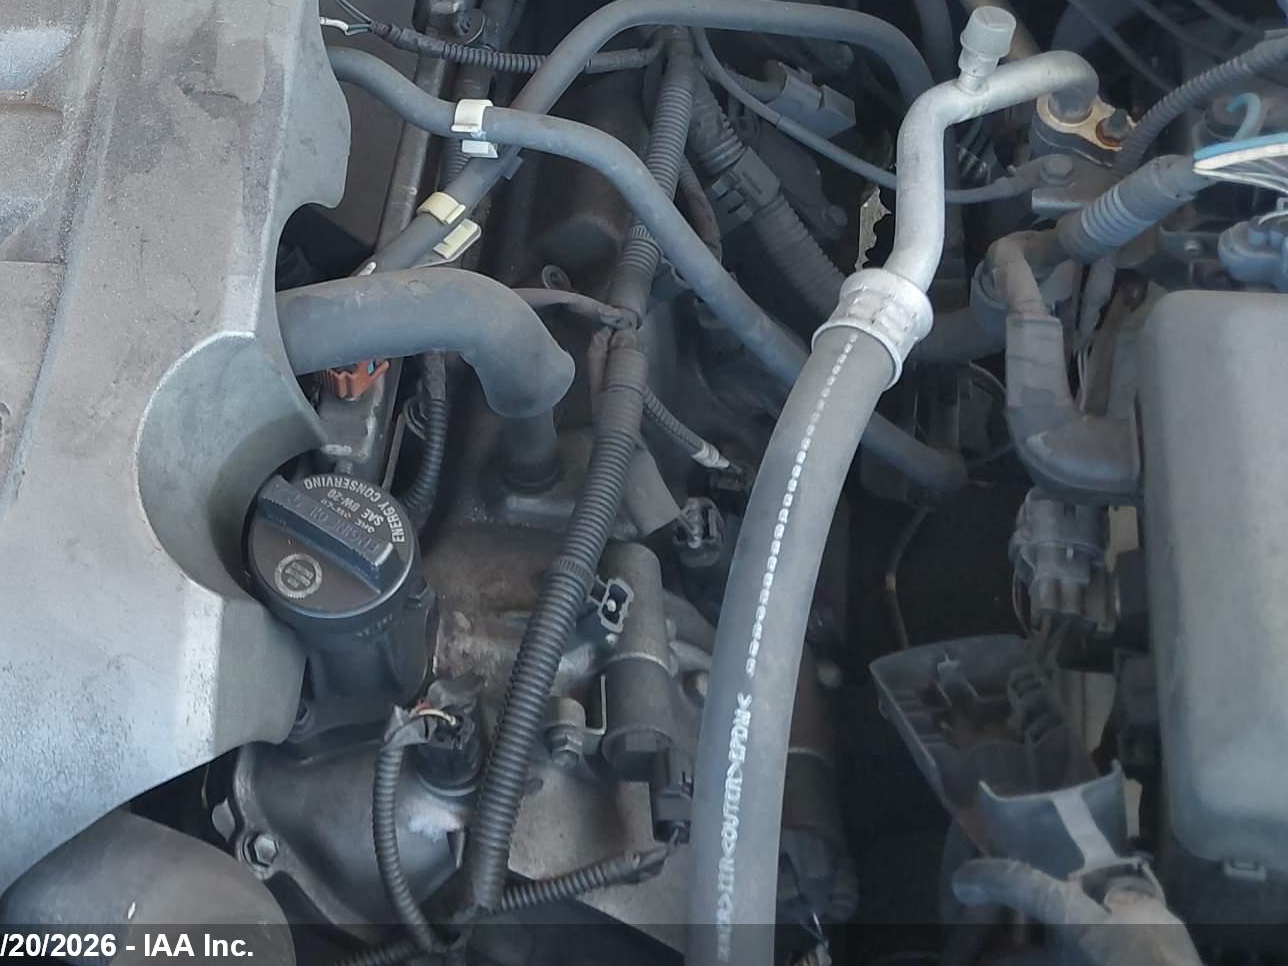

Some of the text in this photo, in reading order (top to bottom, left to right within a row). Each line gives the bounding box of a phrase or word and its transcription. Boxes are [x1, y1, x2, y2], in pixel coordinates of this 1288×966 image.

[304, 475, 405, 543] ENERGY CONSERVING
[327, 489, 384, 527] SAE 0W-20
